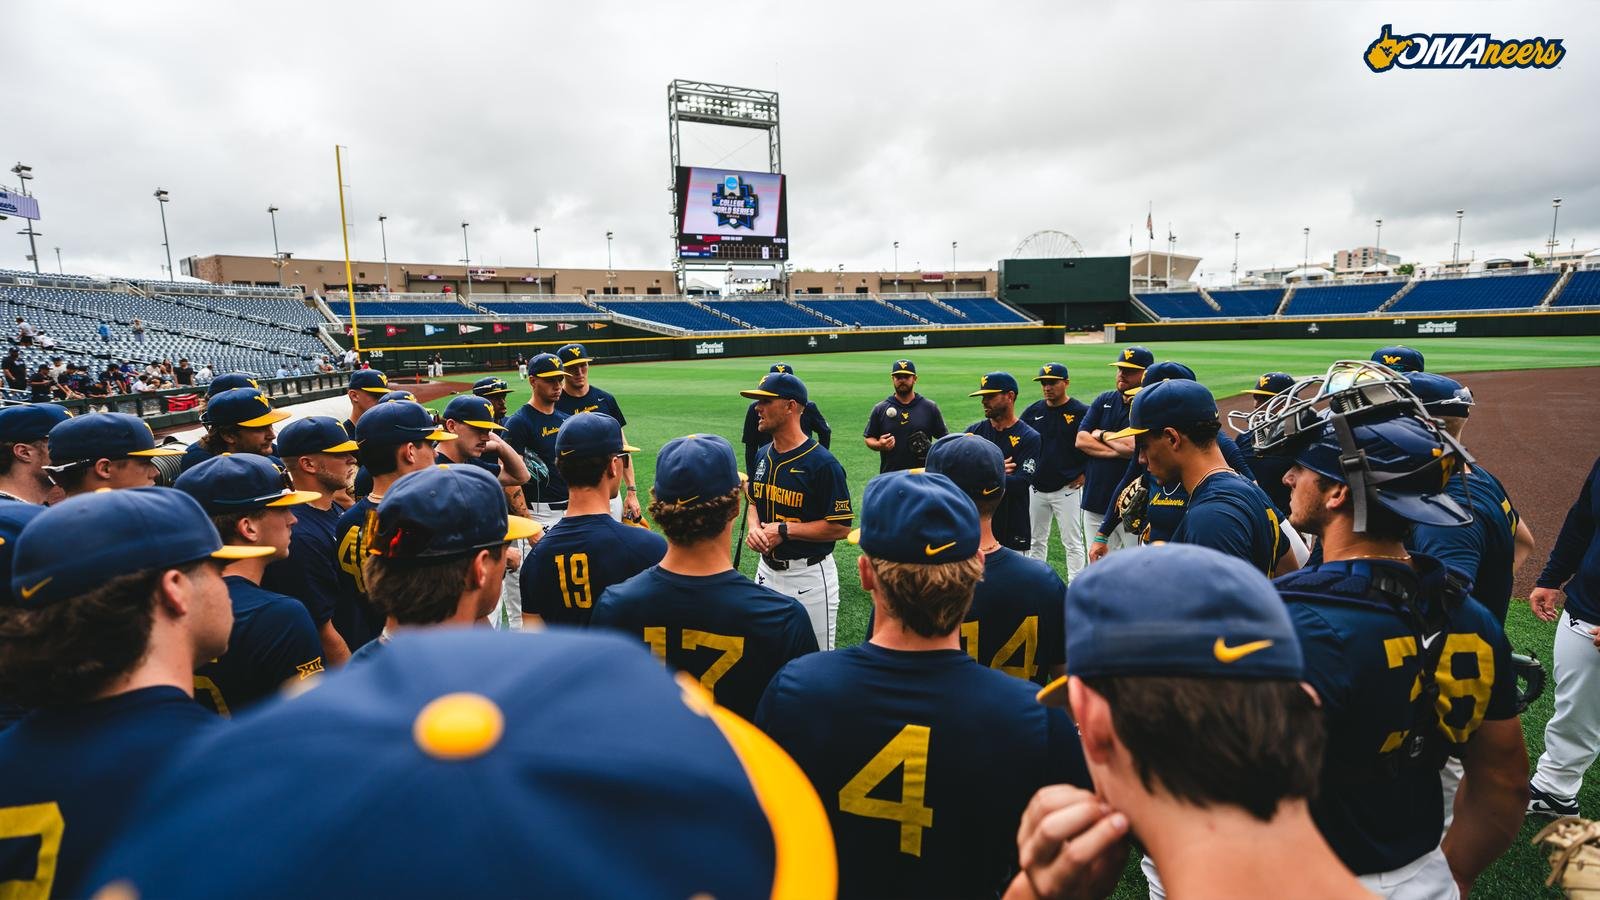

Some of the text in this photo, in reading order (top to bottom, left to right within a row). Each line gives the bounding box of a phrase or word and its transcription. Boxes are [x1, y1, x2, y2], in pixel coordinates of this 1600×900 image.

[720, 198, 745, 207] COLLEGE
[733, 207, 755, 216] SERIES
[370, 350, 383, 358] 335
[766, 484, 804, 508] VIRGINIA
[555, 553, 592, 609] 19
[644, 626, 745, 703] 17
[961, 615, 1039, 681] 14
[838, 723, 934, 858] 4
